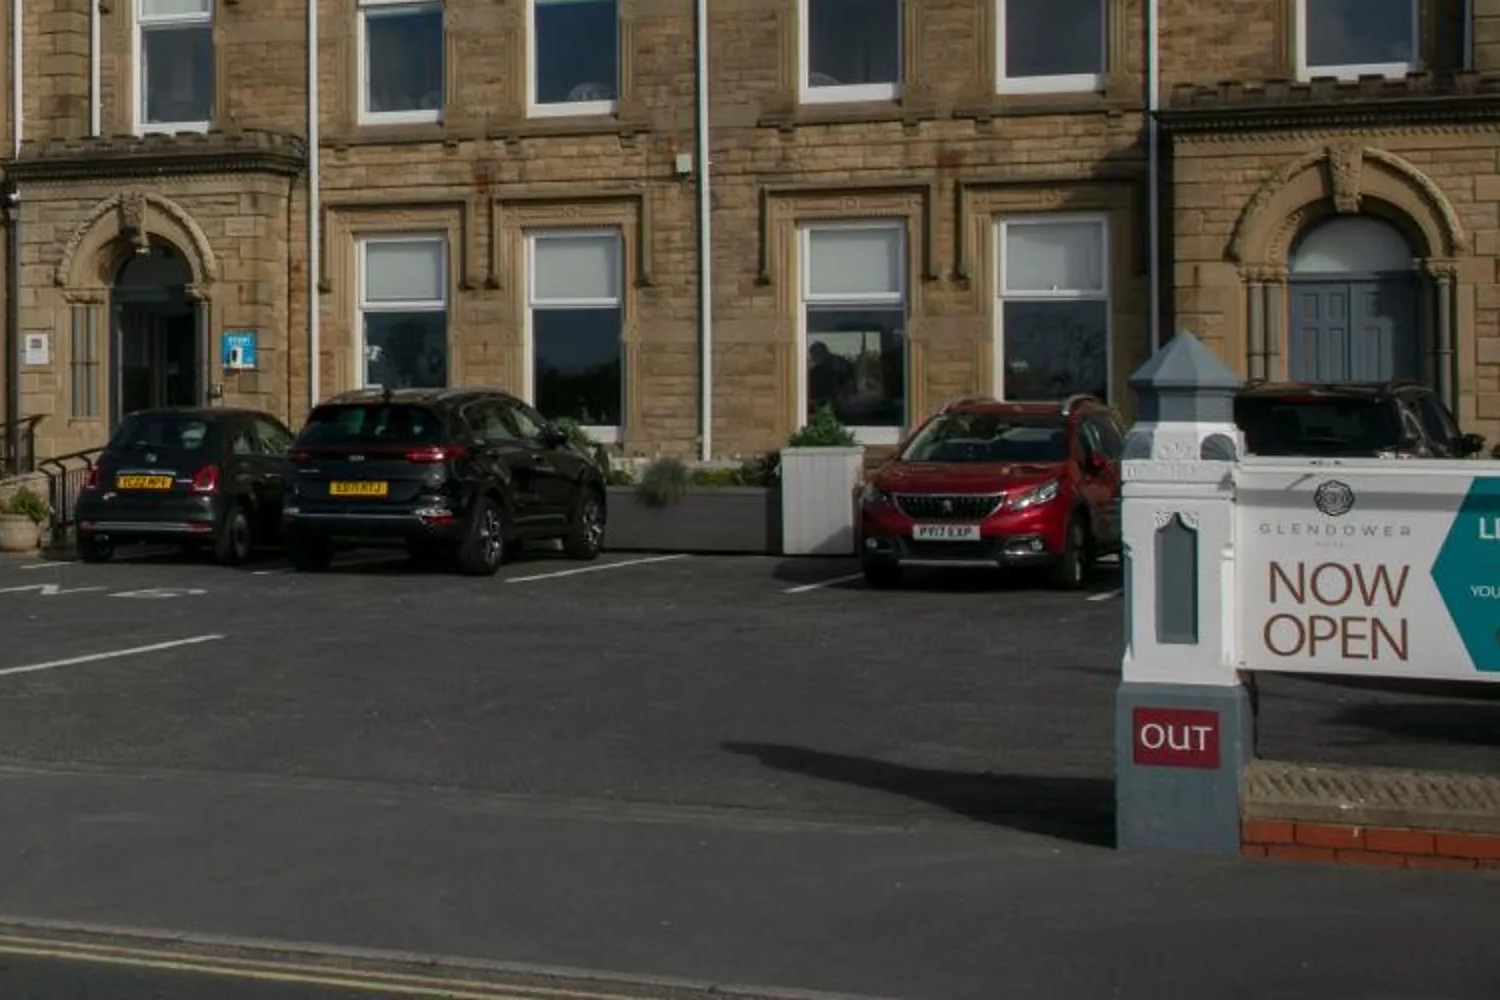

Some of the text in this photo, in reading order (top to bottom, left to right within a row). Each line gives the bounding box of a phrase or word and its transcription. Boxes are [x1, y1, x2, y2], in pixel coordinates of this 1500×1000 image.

[1259, 523, 1412, 537] GLENDOWER
[1269, 561, 1410, 607] NOW
[1263, 613, 1409, 661] OPEN
[1141, 723, 1214, 751] OUT
